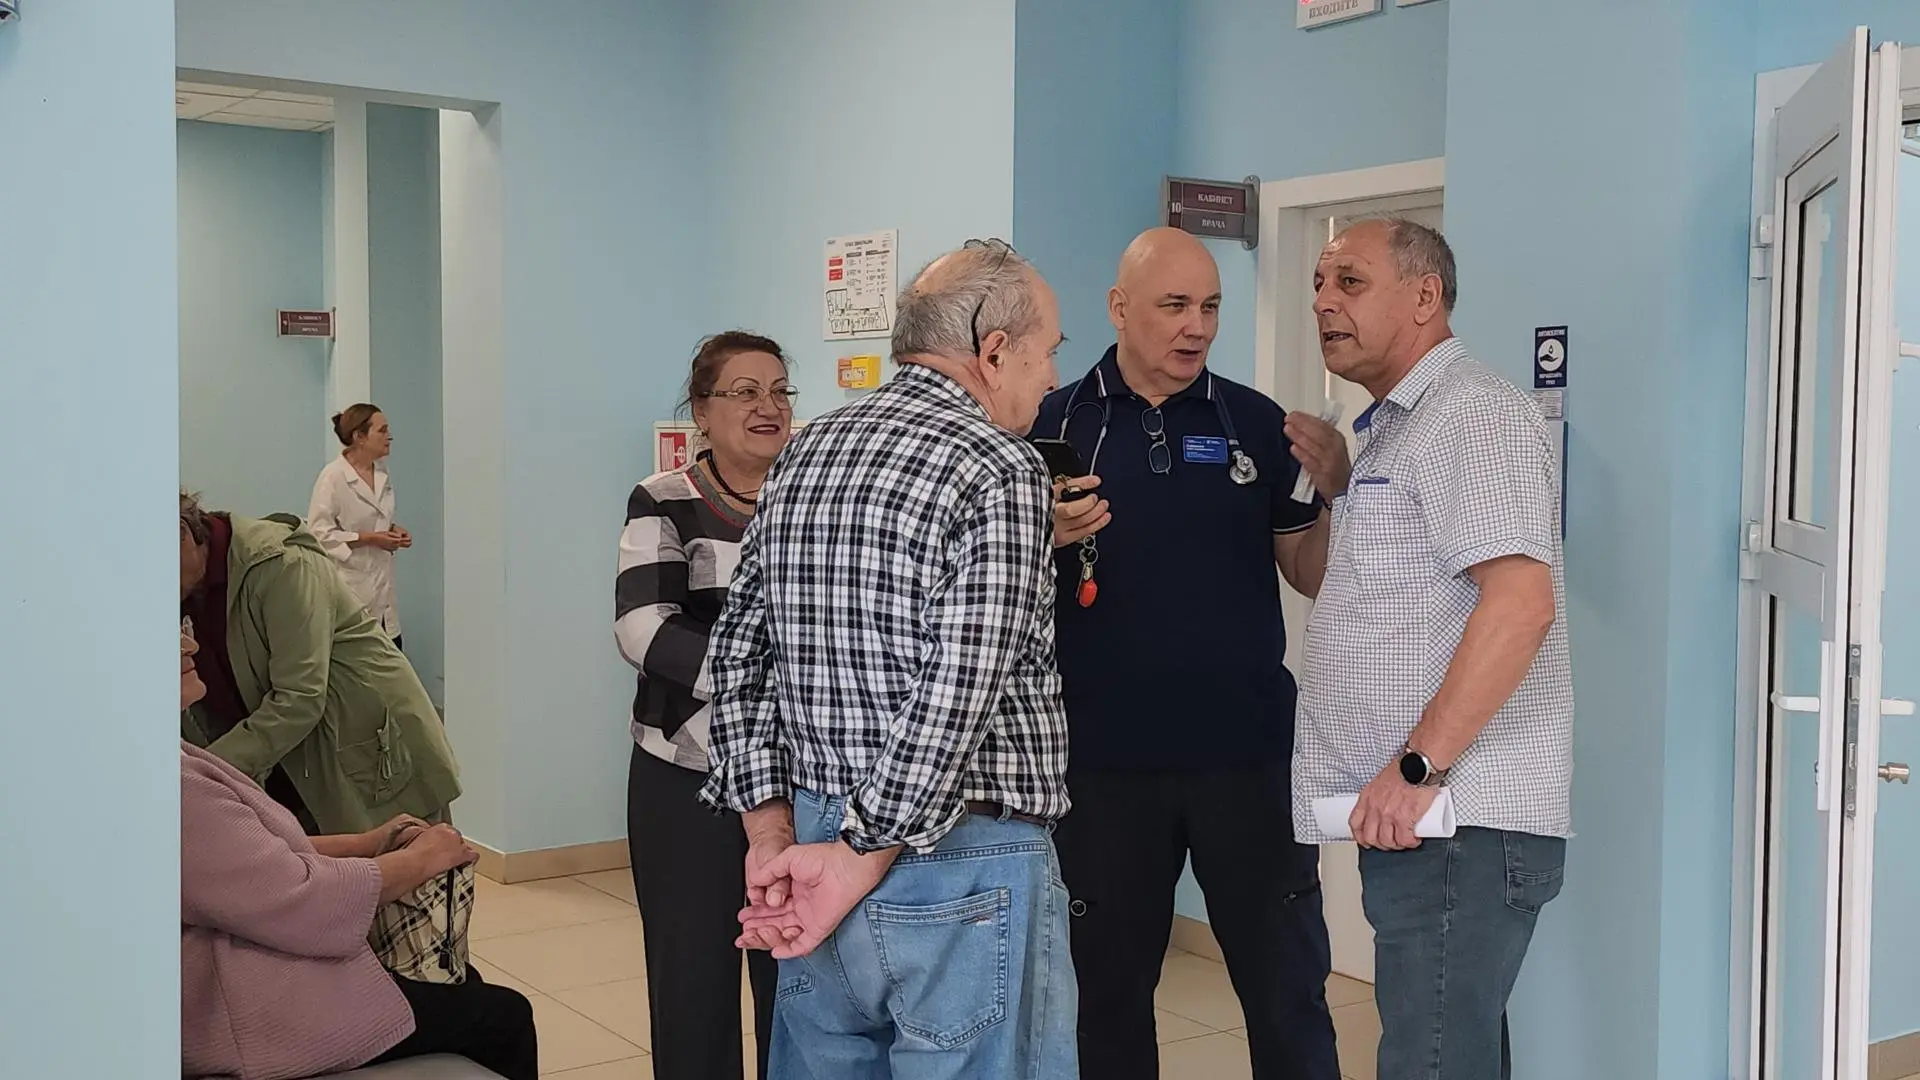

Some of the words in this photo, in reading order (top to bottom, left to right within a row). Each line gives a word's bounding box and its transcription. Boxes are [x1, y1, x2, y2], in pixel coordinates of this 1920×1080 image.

[1198, 193, 1233, 204] КАБИНЕТ
[1171, 202, 1182, 213] 10
[1202, 218, 1226, 228] ВРАЧА
